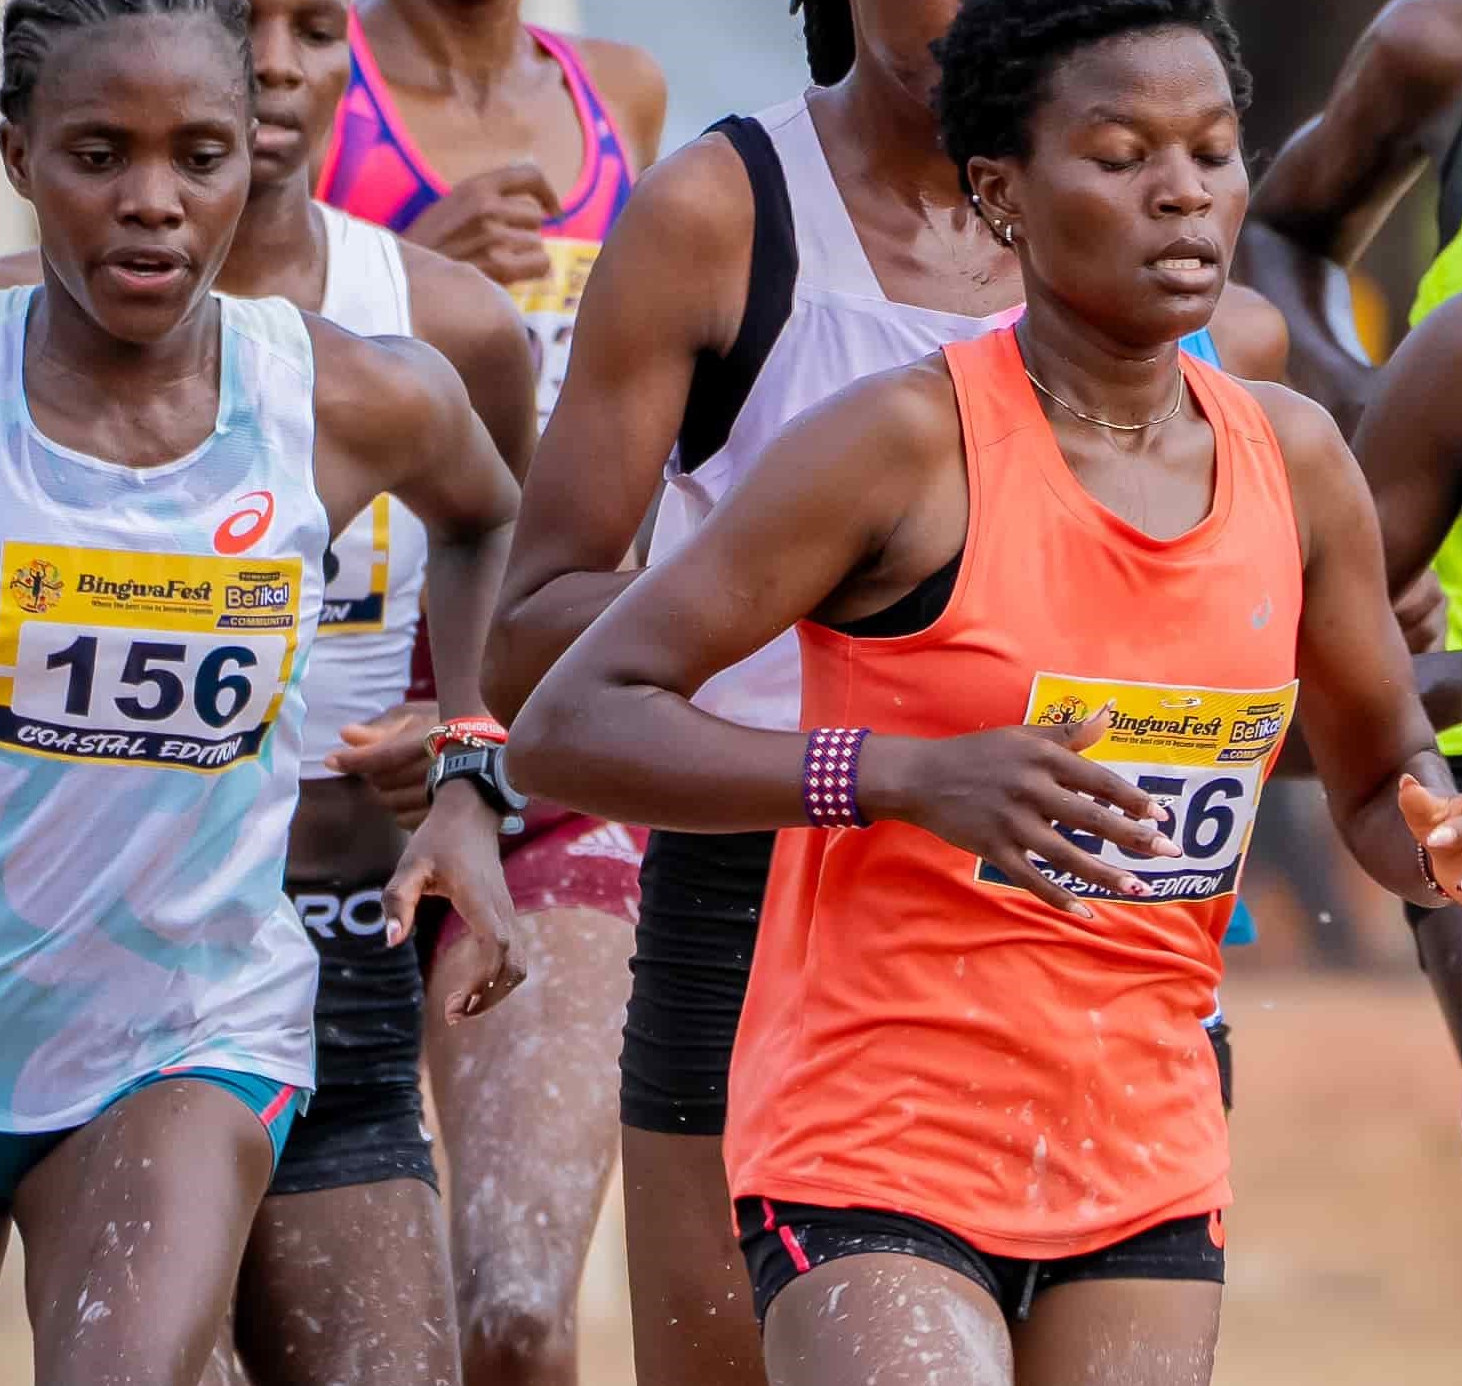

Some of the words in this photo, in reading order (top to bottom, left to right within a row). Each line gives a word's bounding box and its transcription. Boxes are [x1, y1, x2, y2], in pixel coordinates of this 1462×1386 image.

[76, 573, 213, 601] BingwaFest
[45, 635, 258, 729] 156
[17, 724, 146, 755] COASTAL
[158, 736, 243, 764] EDITION
